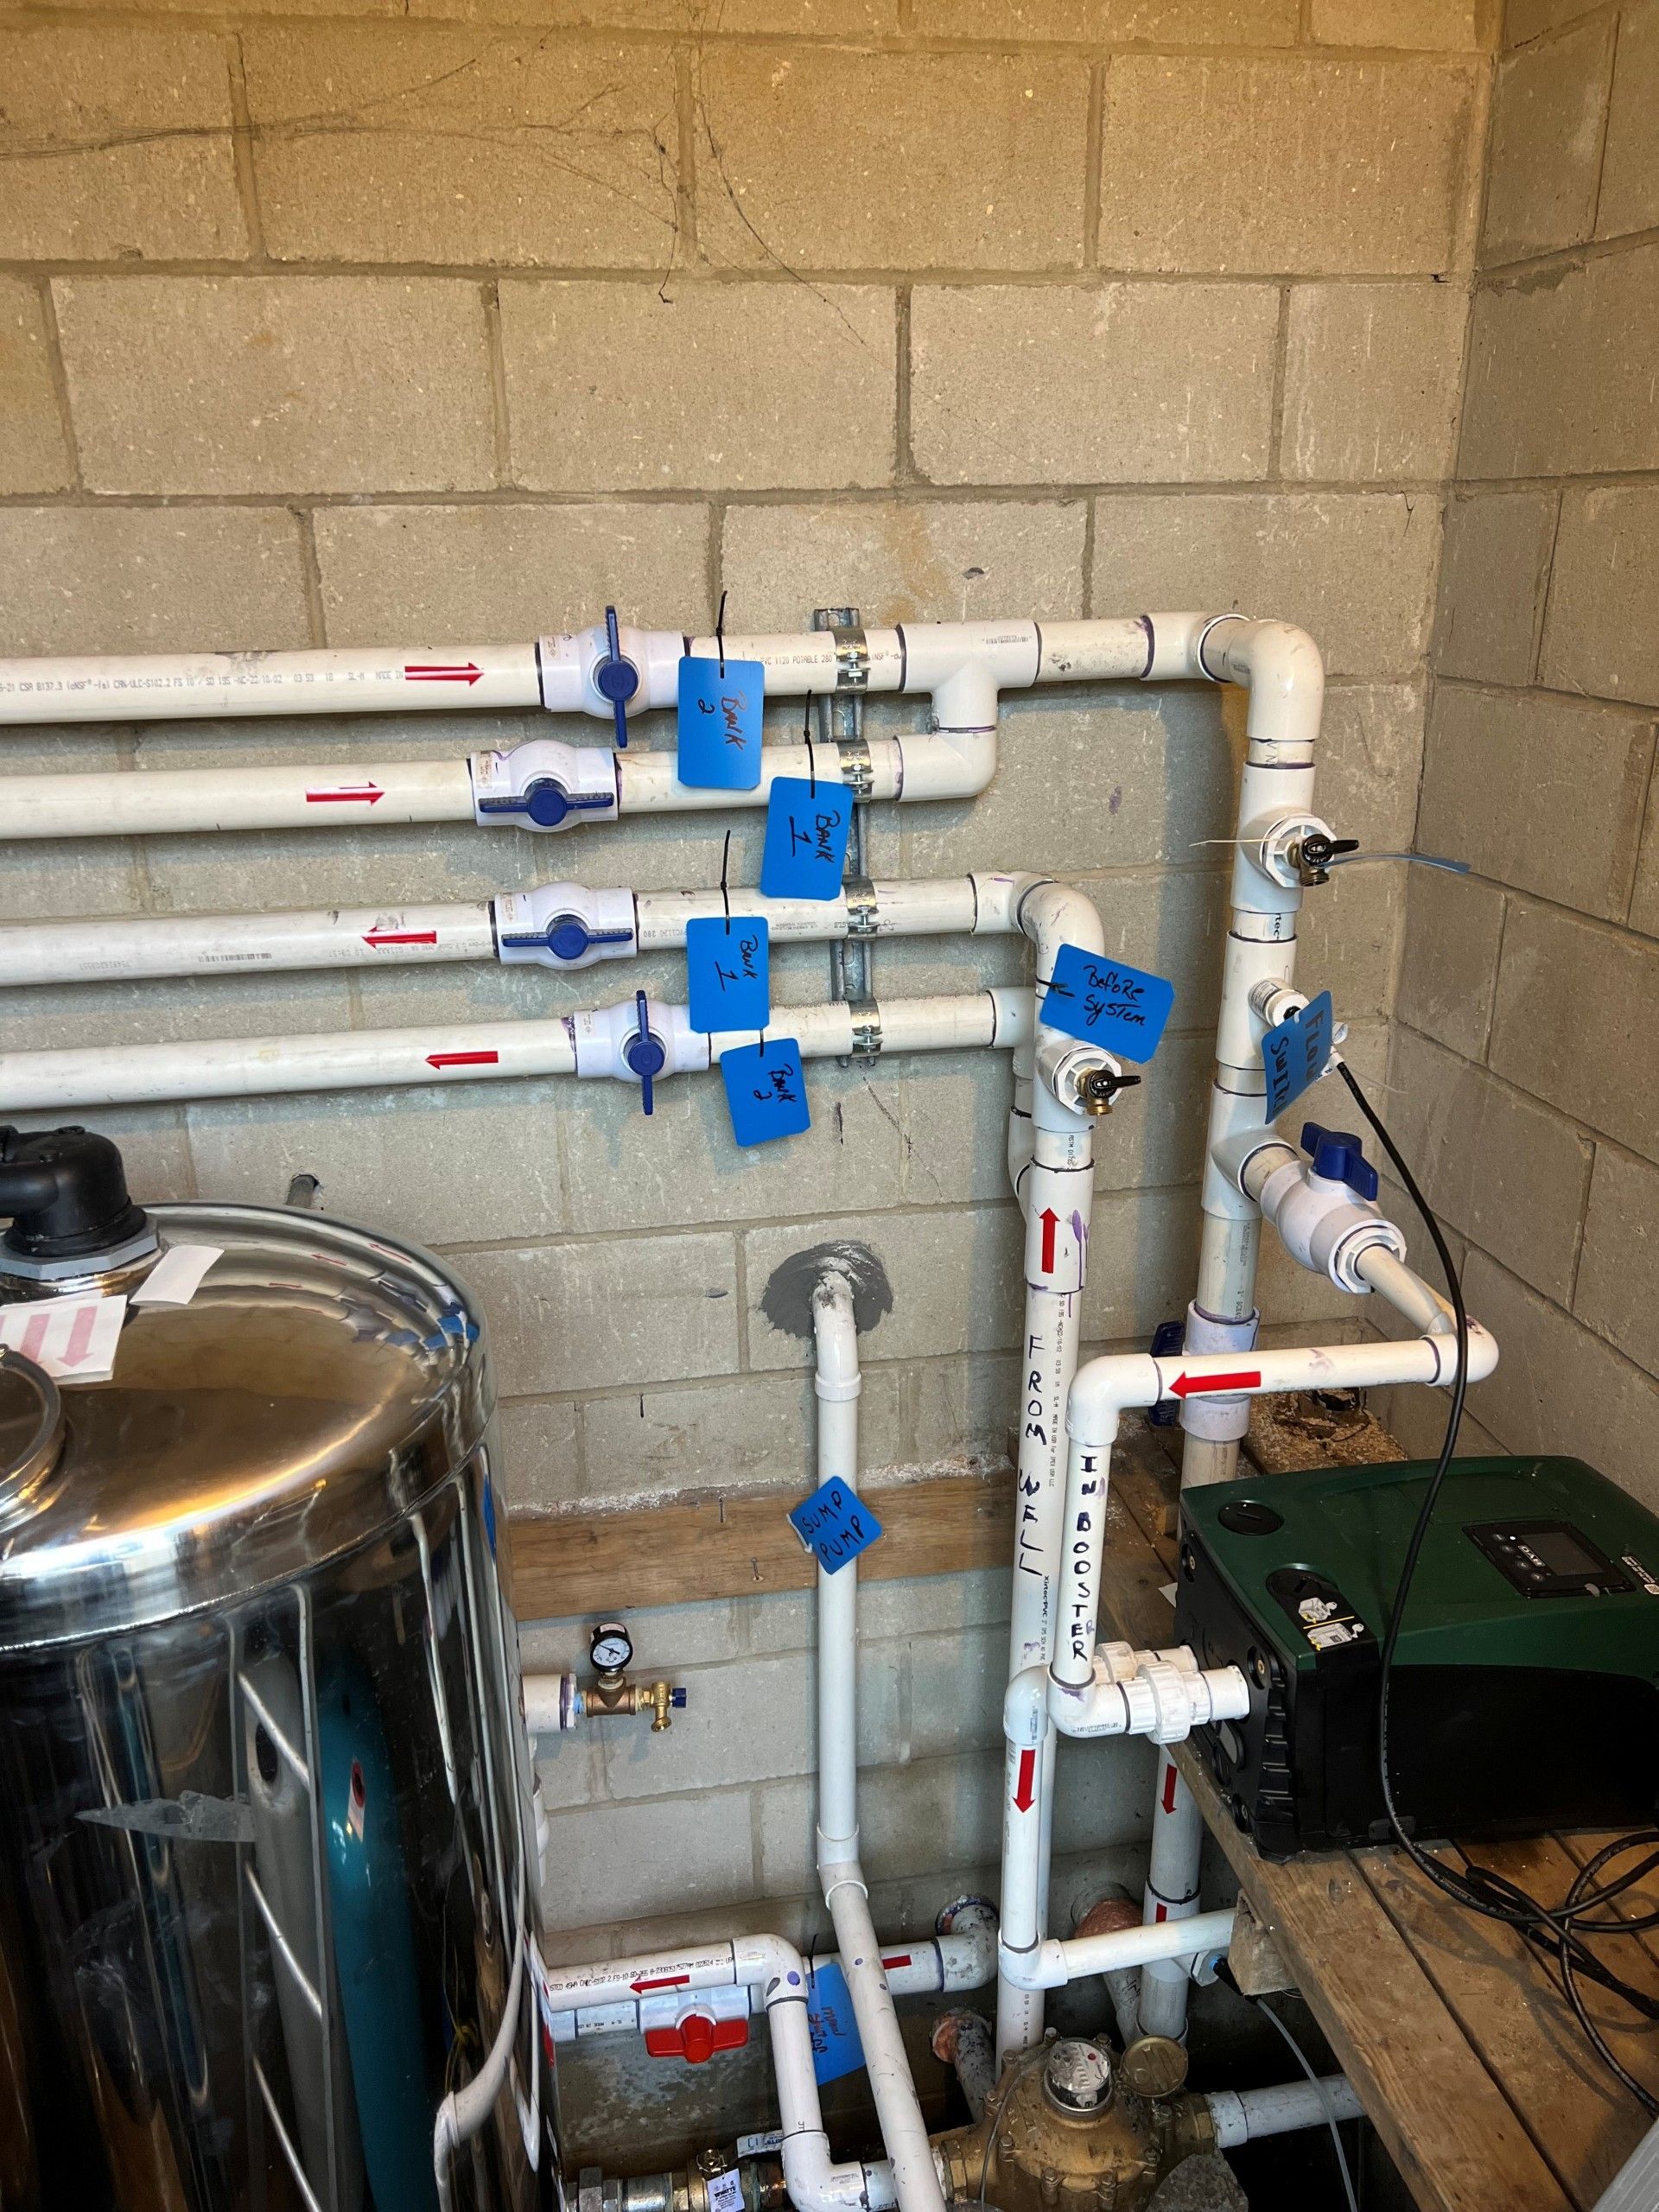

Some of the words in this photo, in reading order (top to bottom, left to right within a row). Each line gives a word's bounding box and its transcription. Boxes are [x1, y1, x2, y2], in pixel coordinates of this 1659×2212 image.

[792, 655, 818, 664] POTABLE
[697, 698, 715, 715] 2
[789, 815, 813, 858] 1
[715, 961, 739, 991] 1
[753, 1089, 773, 1102] 2
[1025, 1335, 1047, 1446] FROM
[1080, 1455, 1097, 1496] IN
[802, 1491, 842, 1534] SUMP
[1017, 1469, 1044, 1576] WELL
[820, 1515, 864, 1562] PUMP
[1071, 1511, 1092, 1662] BOOSTER
